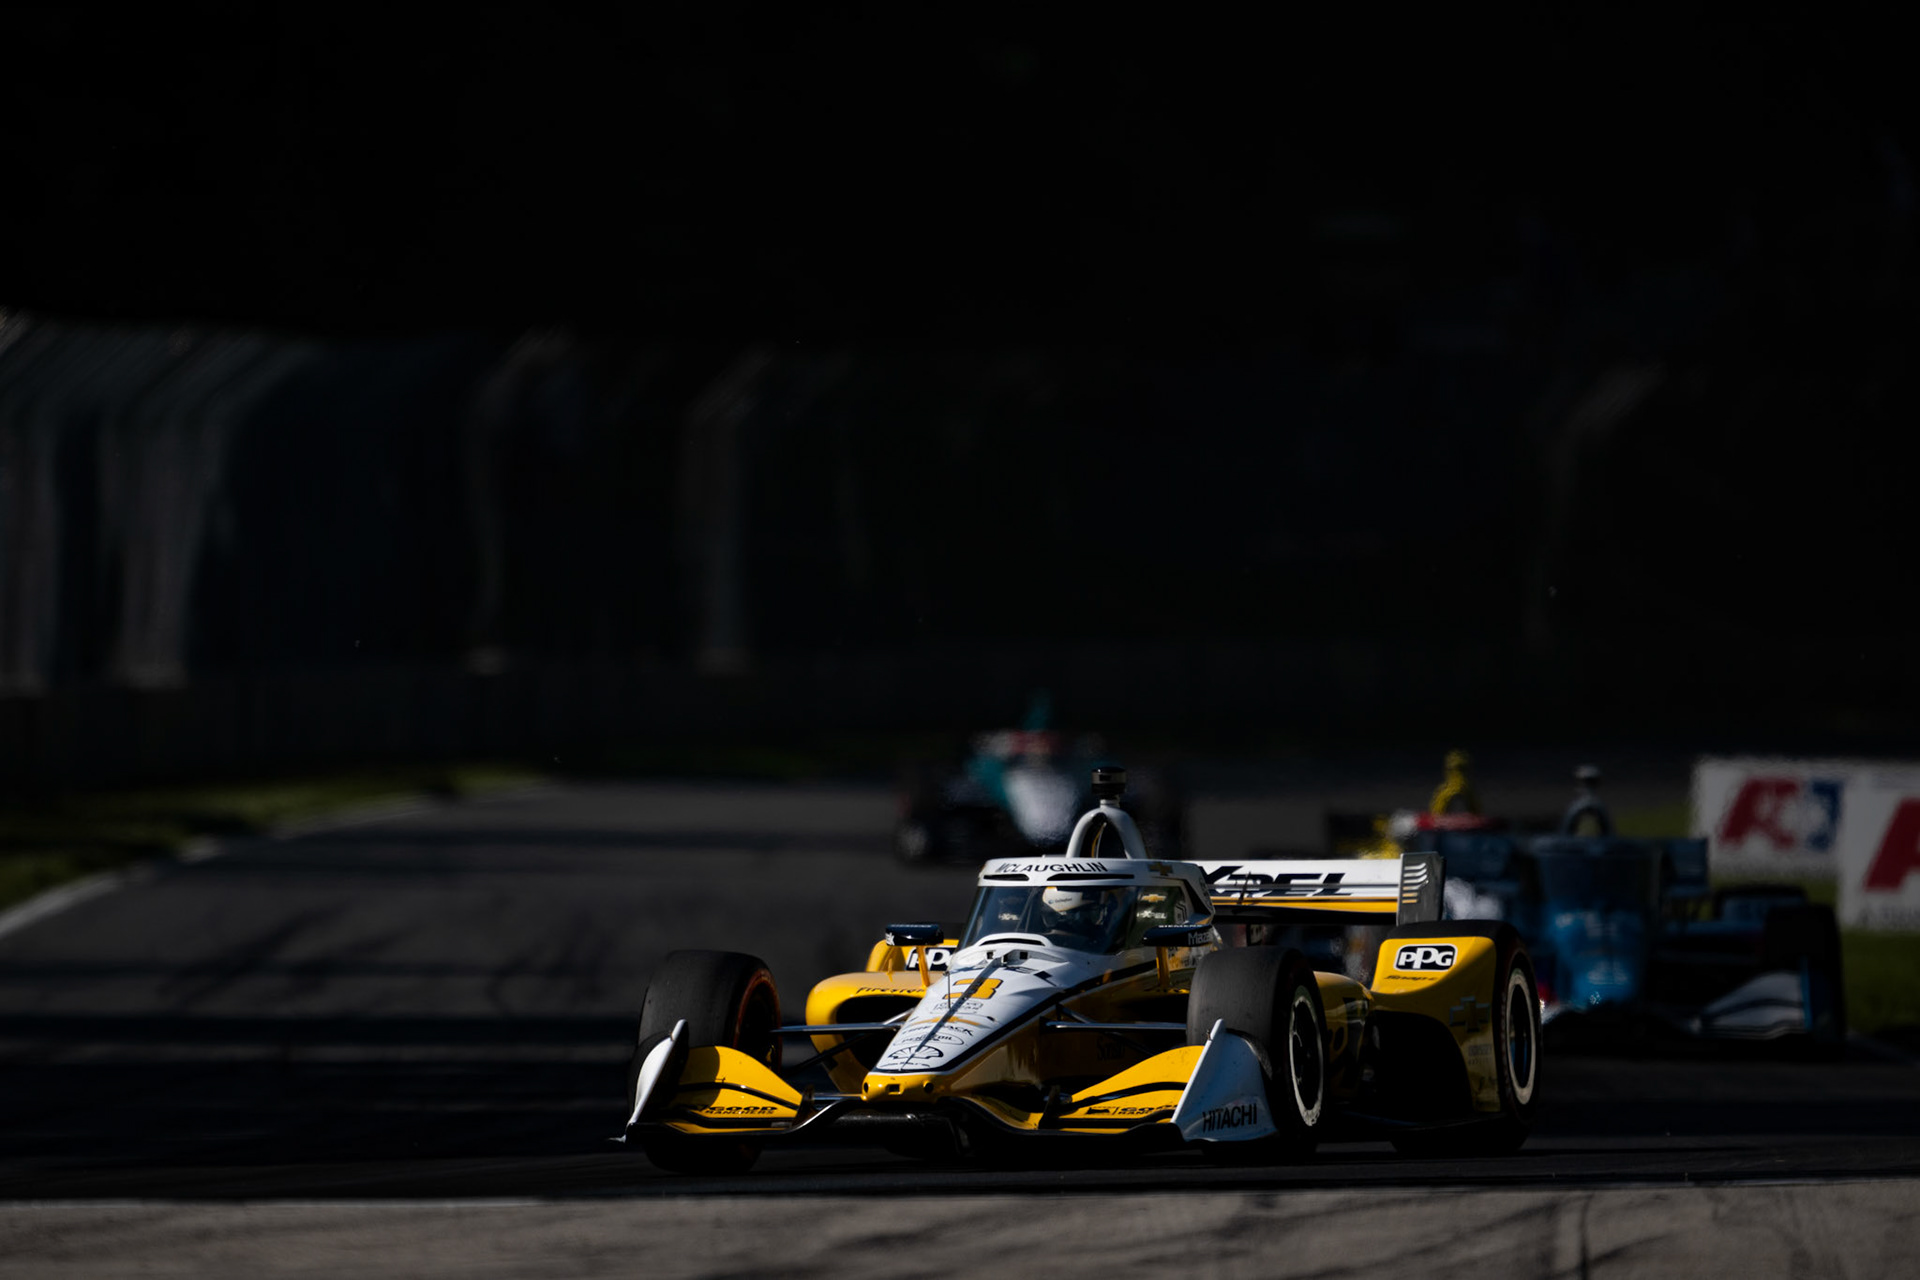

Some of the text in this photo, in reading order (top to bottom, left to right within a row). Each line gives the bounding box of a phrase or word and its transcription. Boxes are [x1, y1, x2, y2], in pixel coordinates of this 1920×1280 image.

[995, 862, 1108, 873] MCLAUGHLIN
[1397, 947, 1454, 970] PPG
[856, 986, 926, 995] Fireston
[942, 977, 1003, 1000] 3
[1203, 1103, 1258, 1133] HITACHI
